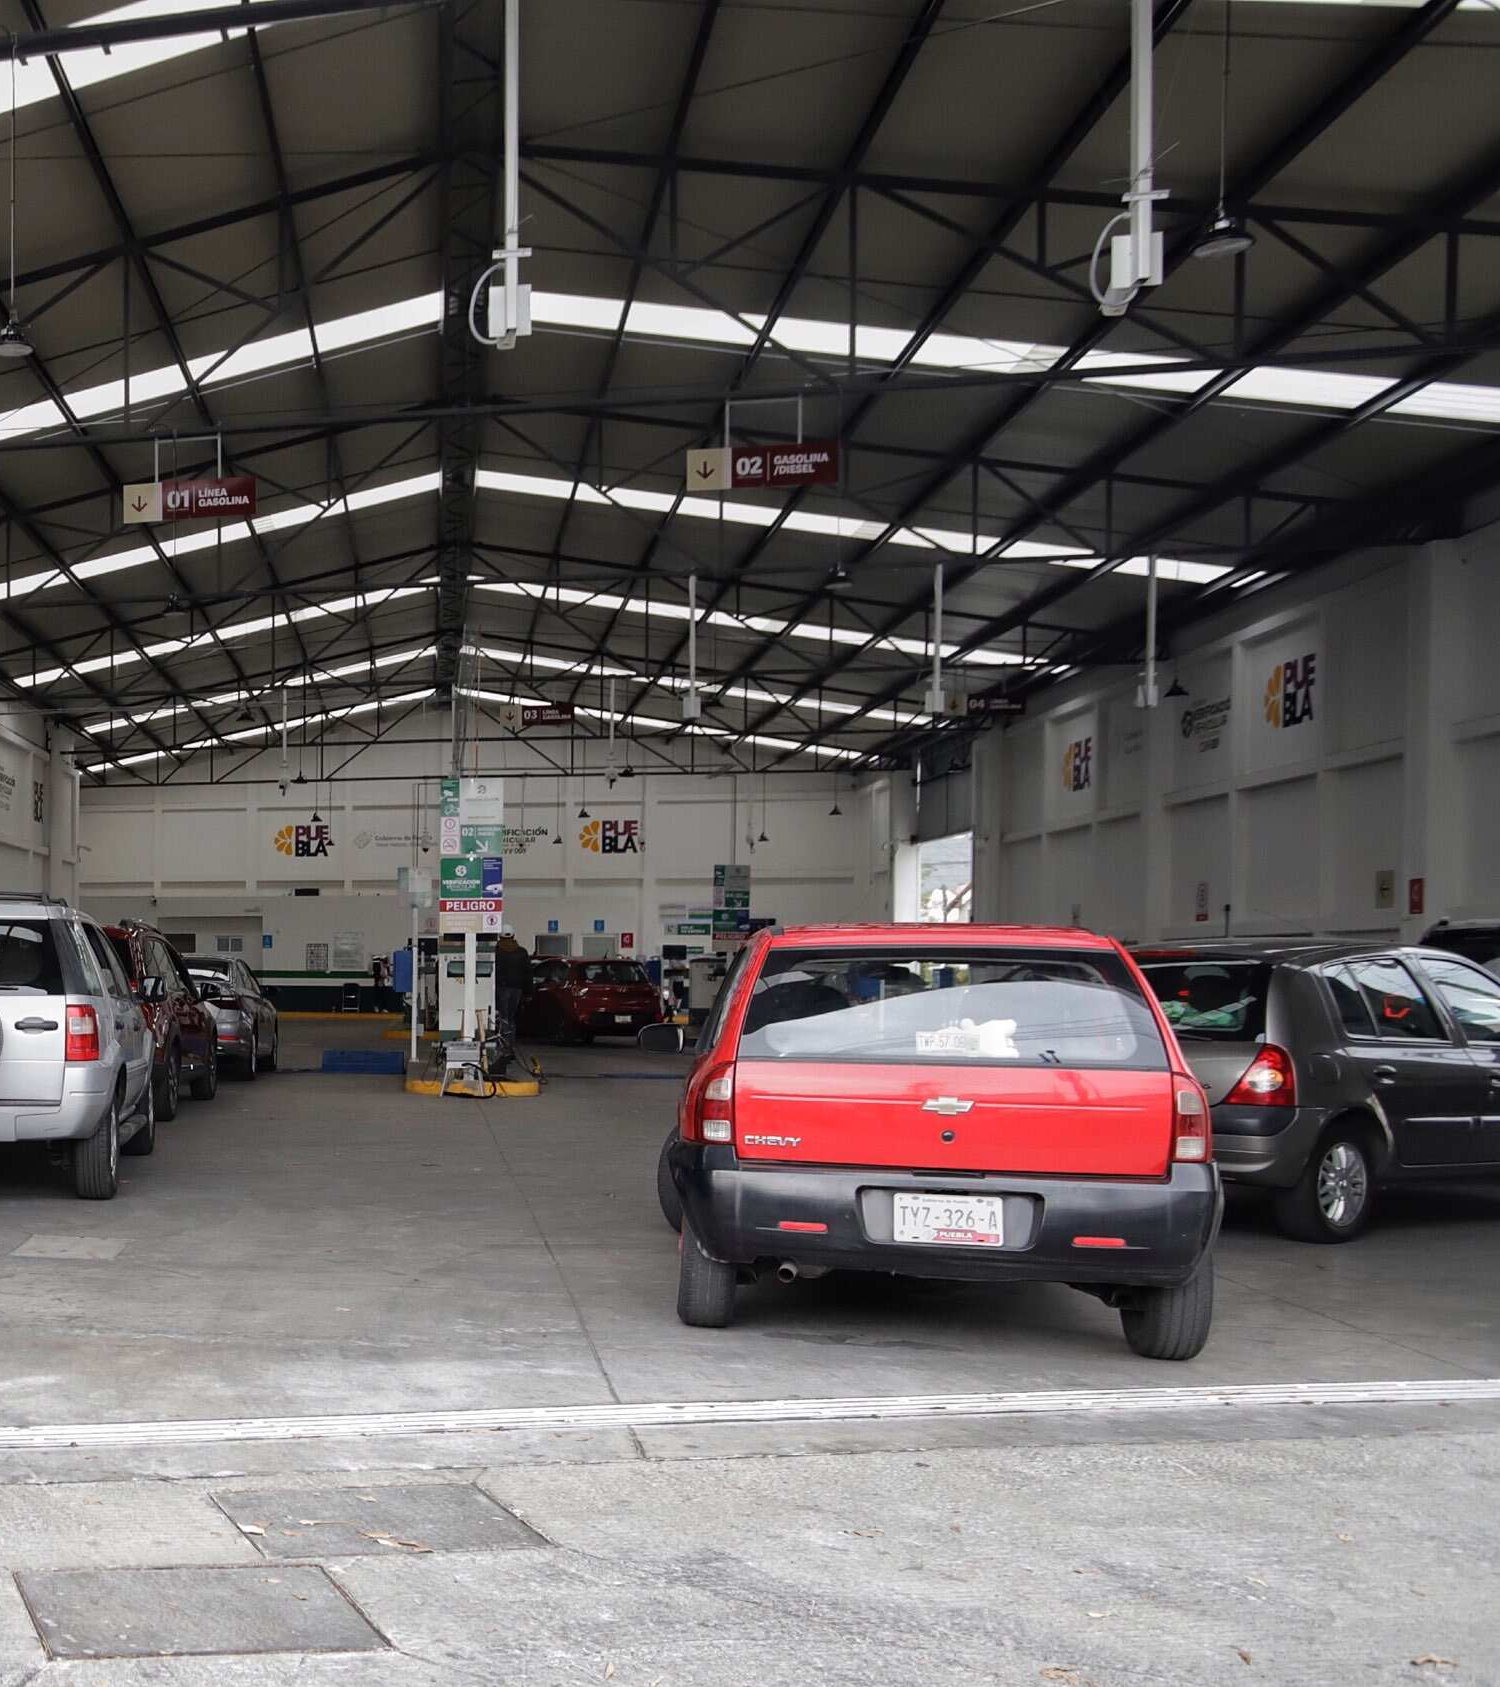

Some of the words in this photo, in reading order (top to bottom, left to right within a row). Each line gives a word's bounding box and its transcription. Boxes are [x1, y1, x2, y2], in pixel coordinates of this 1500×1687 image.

[736, 456, 763, 475] 02
[773, 452, 828, 465] GASOLINA
[167, 489, 190, 509] 01
[198, 487, 228, 498] LÍNEA
[198, 496, 250, 507] GASOLINA
[1283, 653, 1316, 690] PUE
[523, 709, 538, 720] 03
[1282, 686, 1313, 728] BLA
[294, 825, 329, 841] PUE
[462, 827, 474, 837] 02
[601, 820, 639, 836] PUE
[294, 839, 329, 857] BLA
[601, 835, 638, 853] BLA
[445, 901, 496, 911] PELIGRO
[743, 1134, 802, 1147] CHEVY
[899, 1205, 998, 1231] TYZ-326-A
[939, 1231, 973, 1239] PUEBLA
